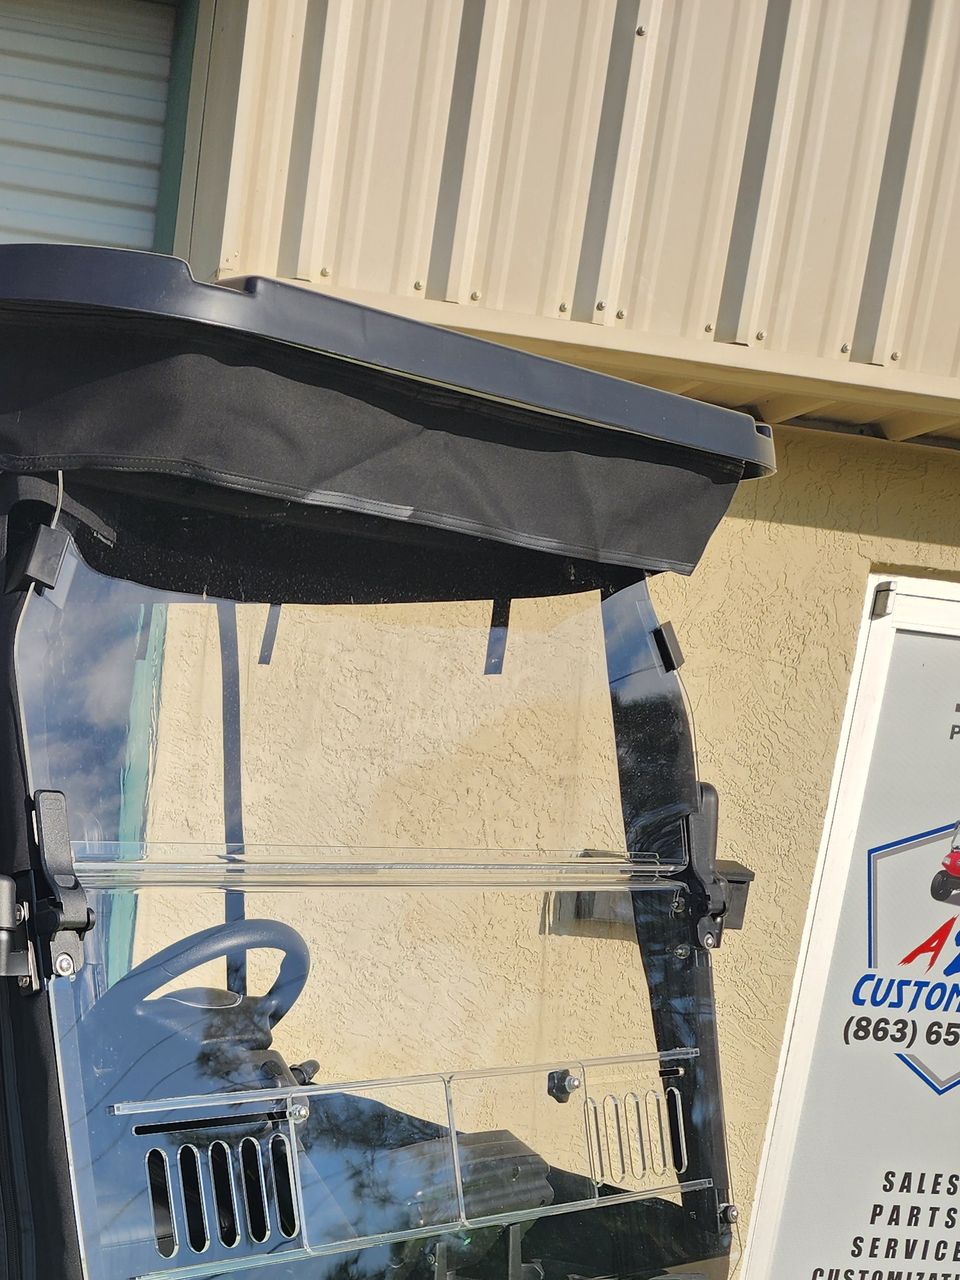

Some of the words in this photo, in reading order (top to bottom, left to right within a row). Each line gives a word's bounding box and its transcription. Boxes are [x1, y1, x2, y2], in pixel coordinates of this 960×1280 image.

[843, 1016, 918, 1048] (863)
[925, 1021, 960, 1046] 65
[882, 1171, 960, 1195] SALES
[869, 1204, 958, 1229] PARTS
